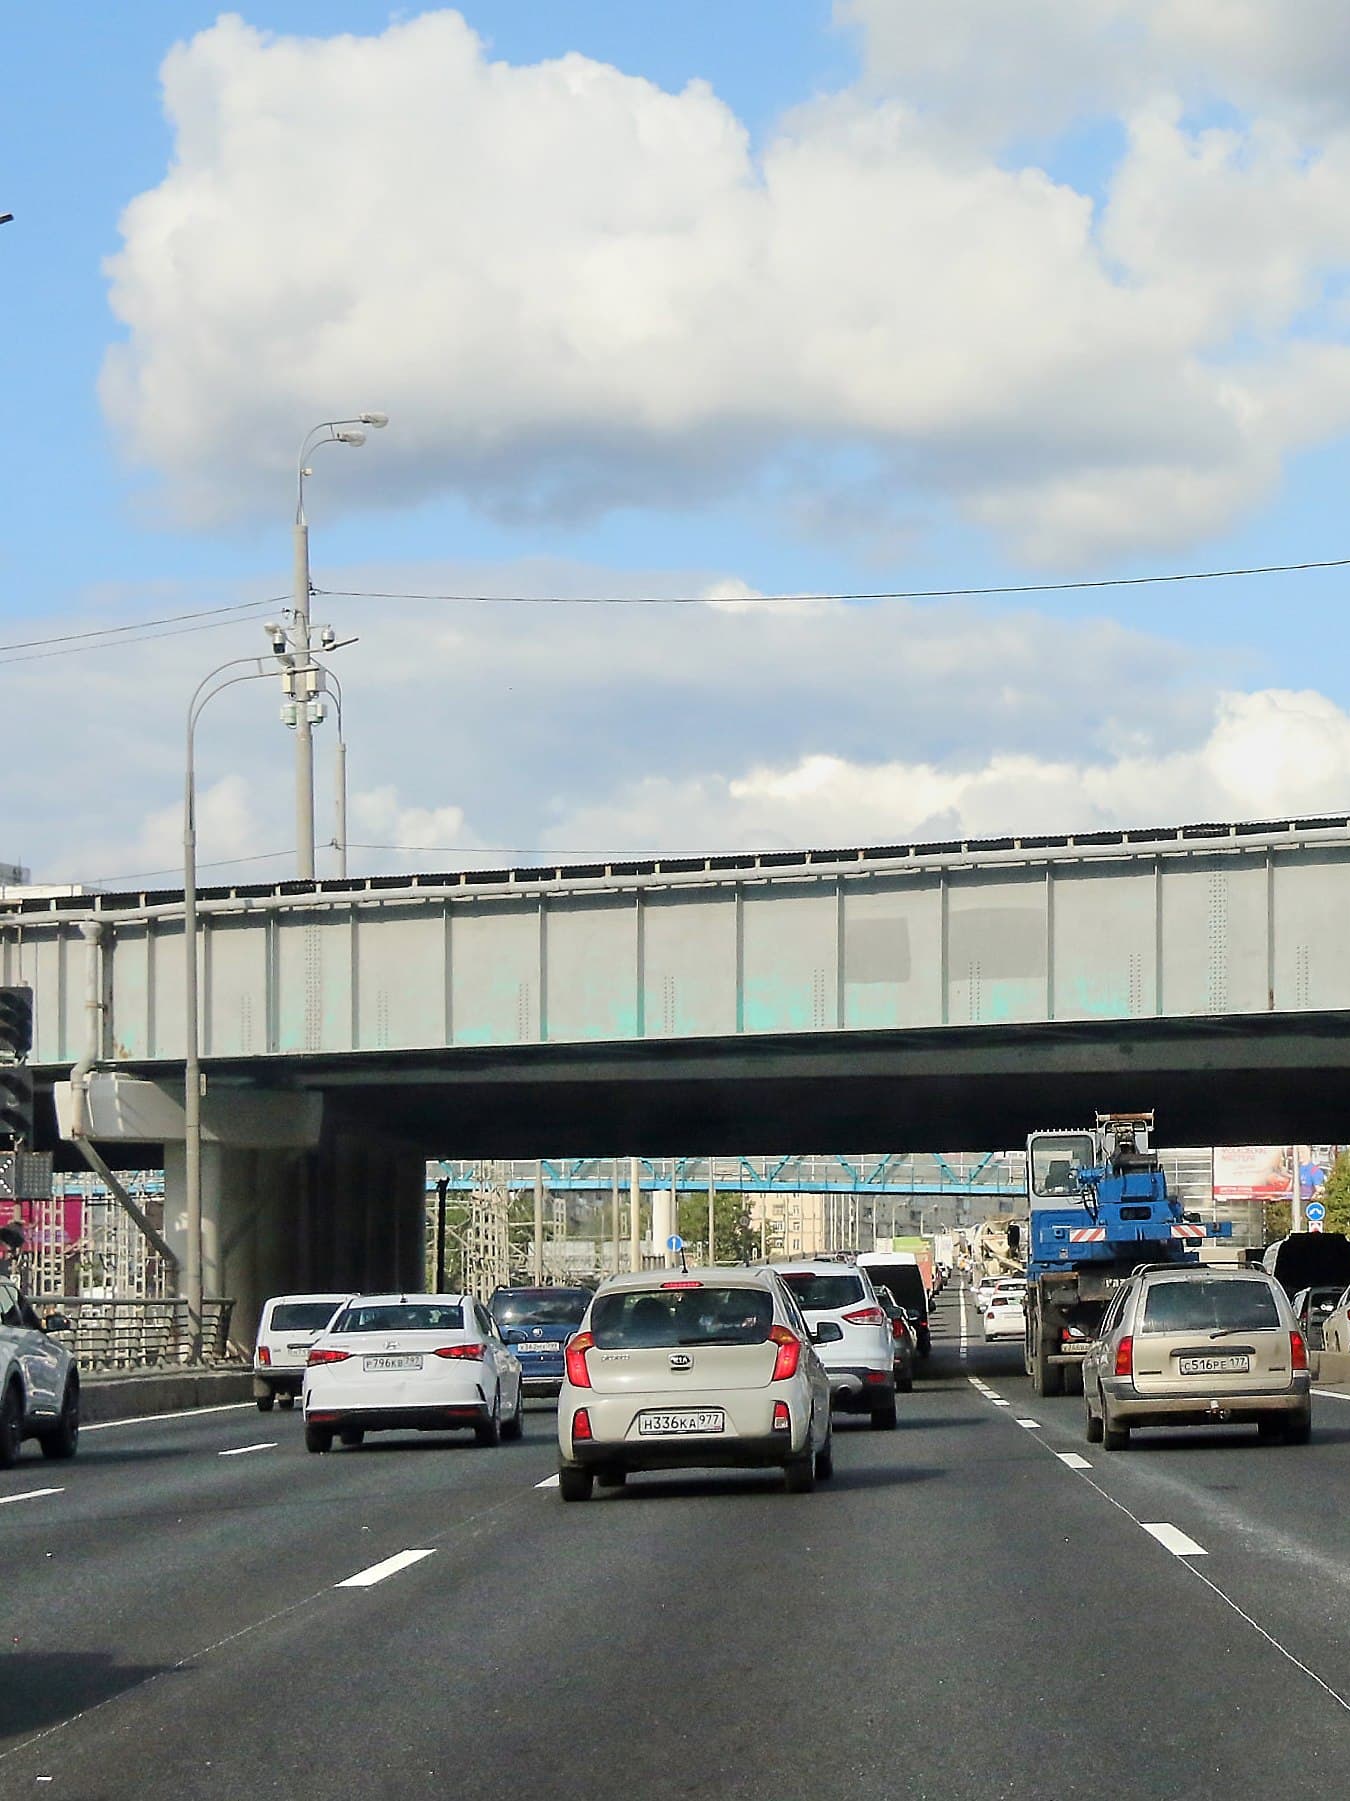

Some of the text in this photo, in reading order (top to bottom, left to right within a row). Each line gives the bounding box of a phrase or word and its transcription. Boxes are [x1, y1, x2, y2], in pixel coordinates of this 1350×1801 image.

[1230, 1358, 1245, 1367] 177
[644, 1414, 719, 1430] Н336КА 977
